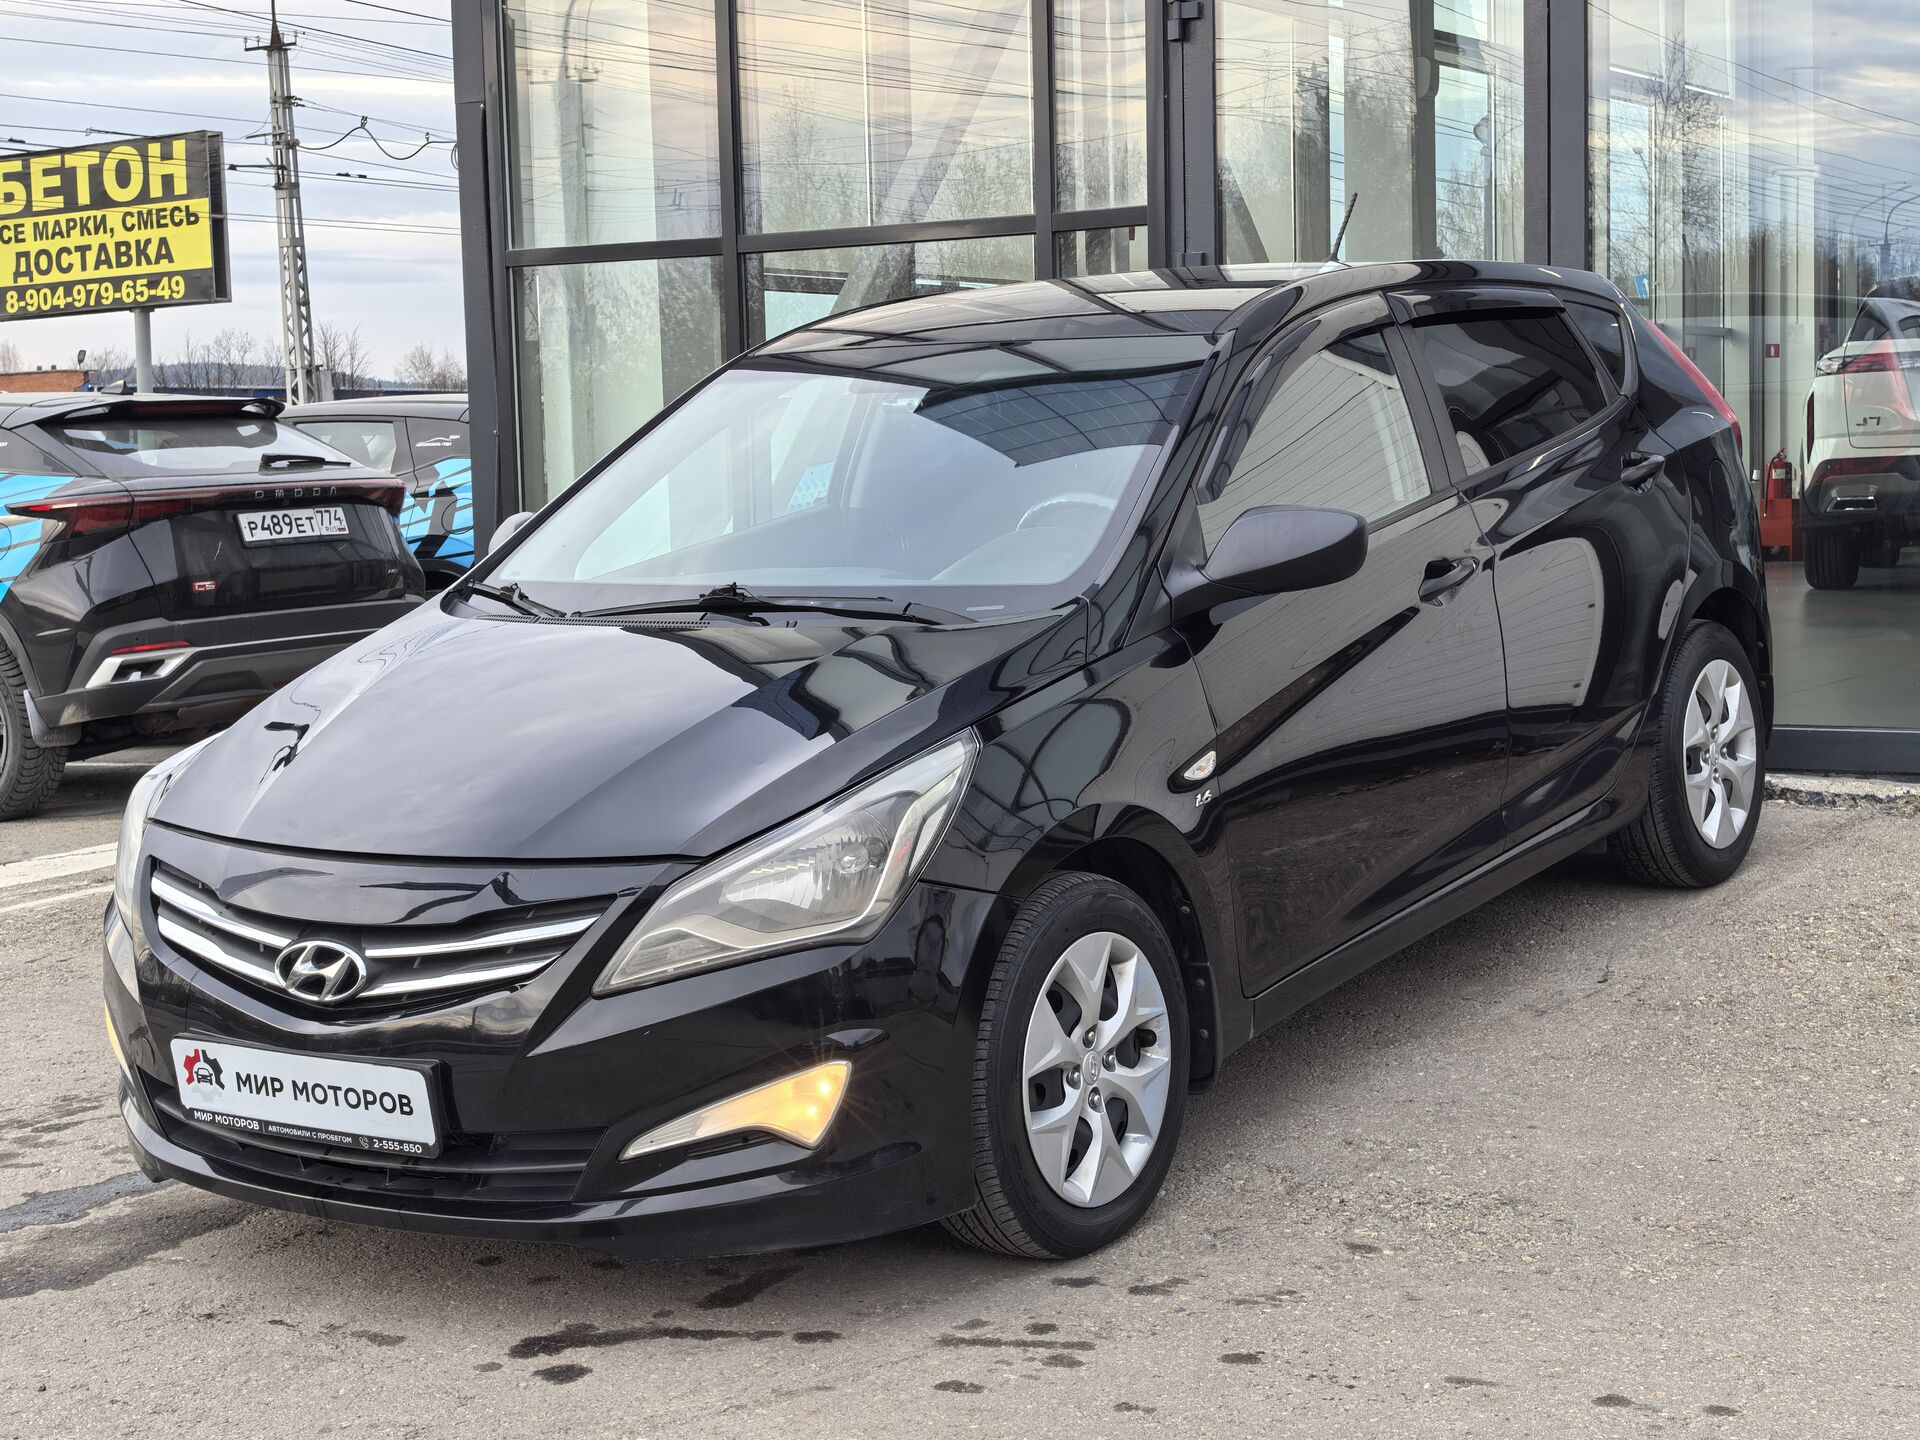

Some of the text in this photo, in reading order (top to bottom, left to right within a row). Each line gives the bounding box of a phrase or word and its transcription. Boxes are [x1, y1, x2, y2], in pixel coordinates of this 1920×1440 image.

[0, 138, 187, 215] БЕТОН
[0, 205, 200, 245] СЕ МАРКИ, СМЕСЬ
[13, 236, 175, 284] ДОСТАВКА
[6, 275, 186, 314] 8-904-979-65-49
[316, 509, 344, 526] 774
[235, 1071, 414, 1116] МИР МОТОРОВ
[193, 1110, 260, 1130] МИР МОТОРОВ
[268, 1125, 311, 1137] АВТОМОБИЛИ
[317, 1133, 353, 1143] ПРОБЕГОМ
[373, 1139, 423, 1154] 2-555-850
